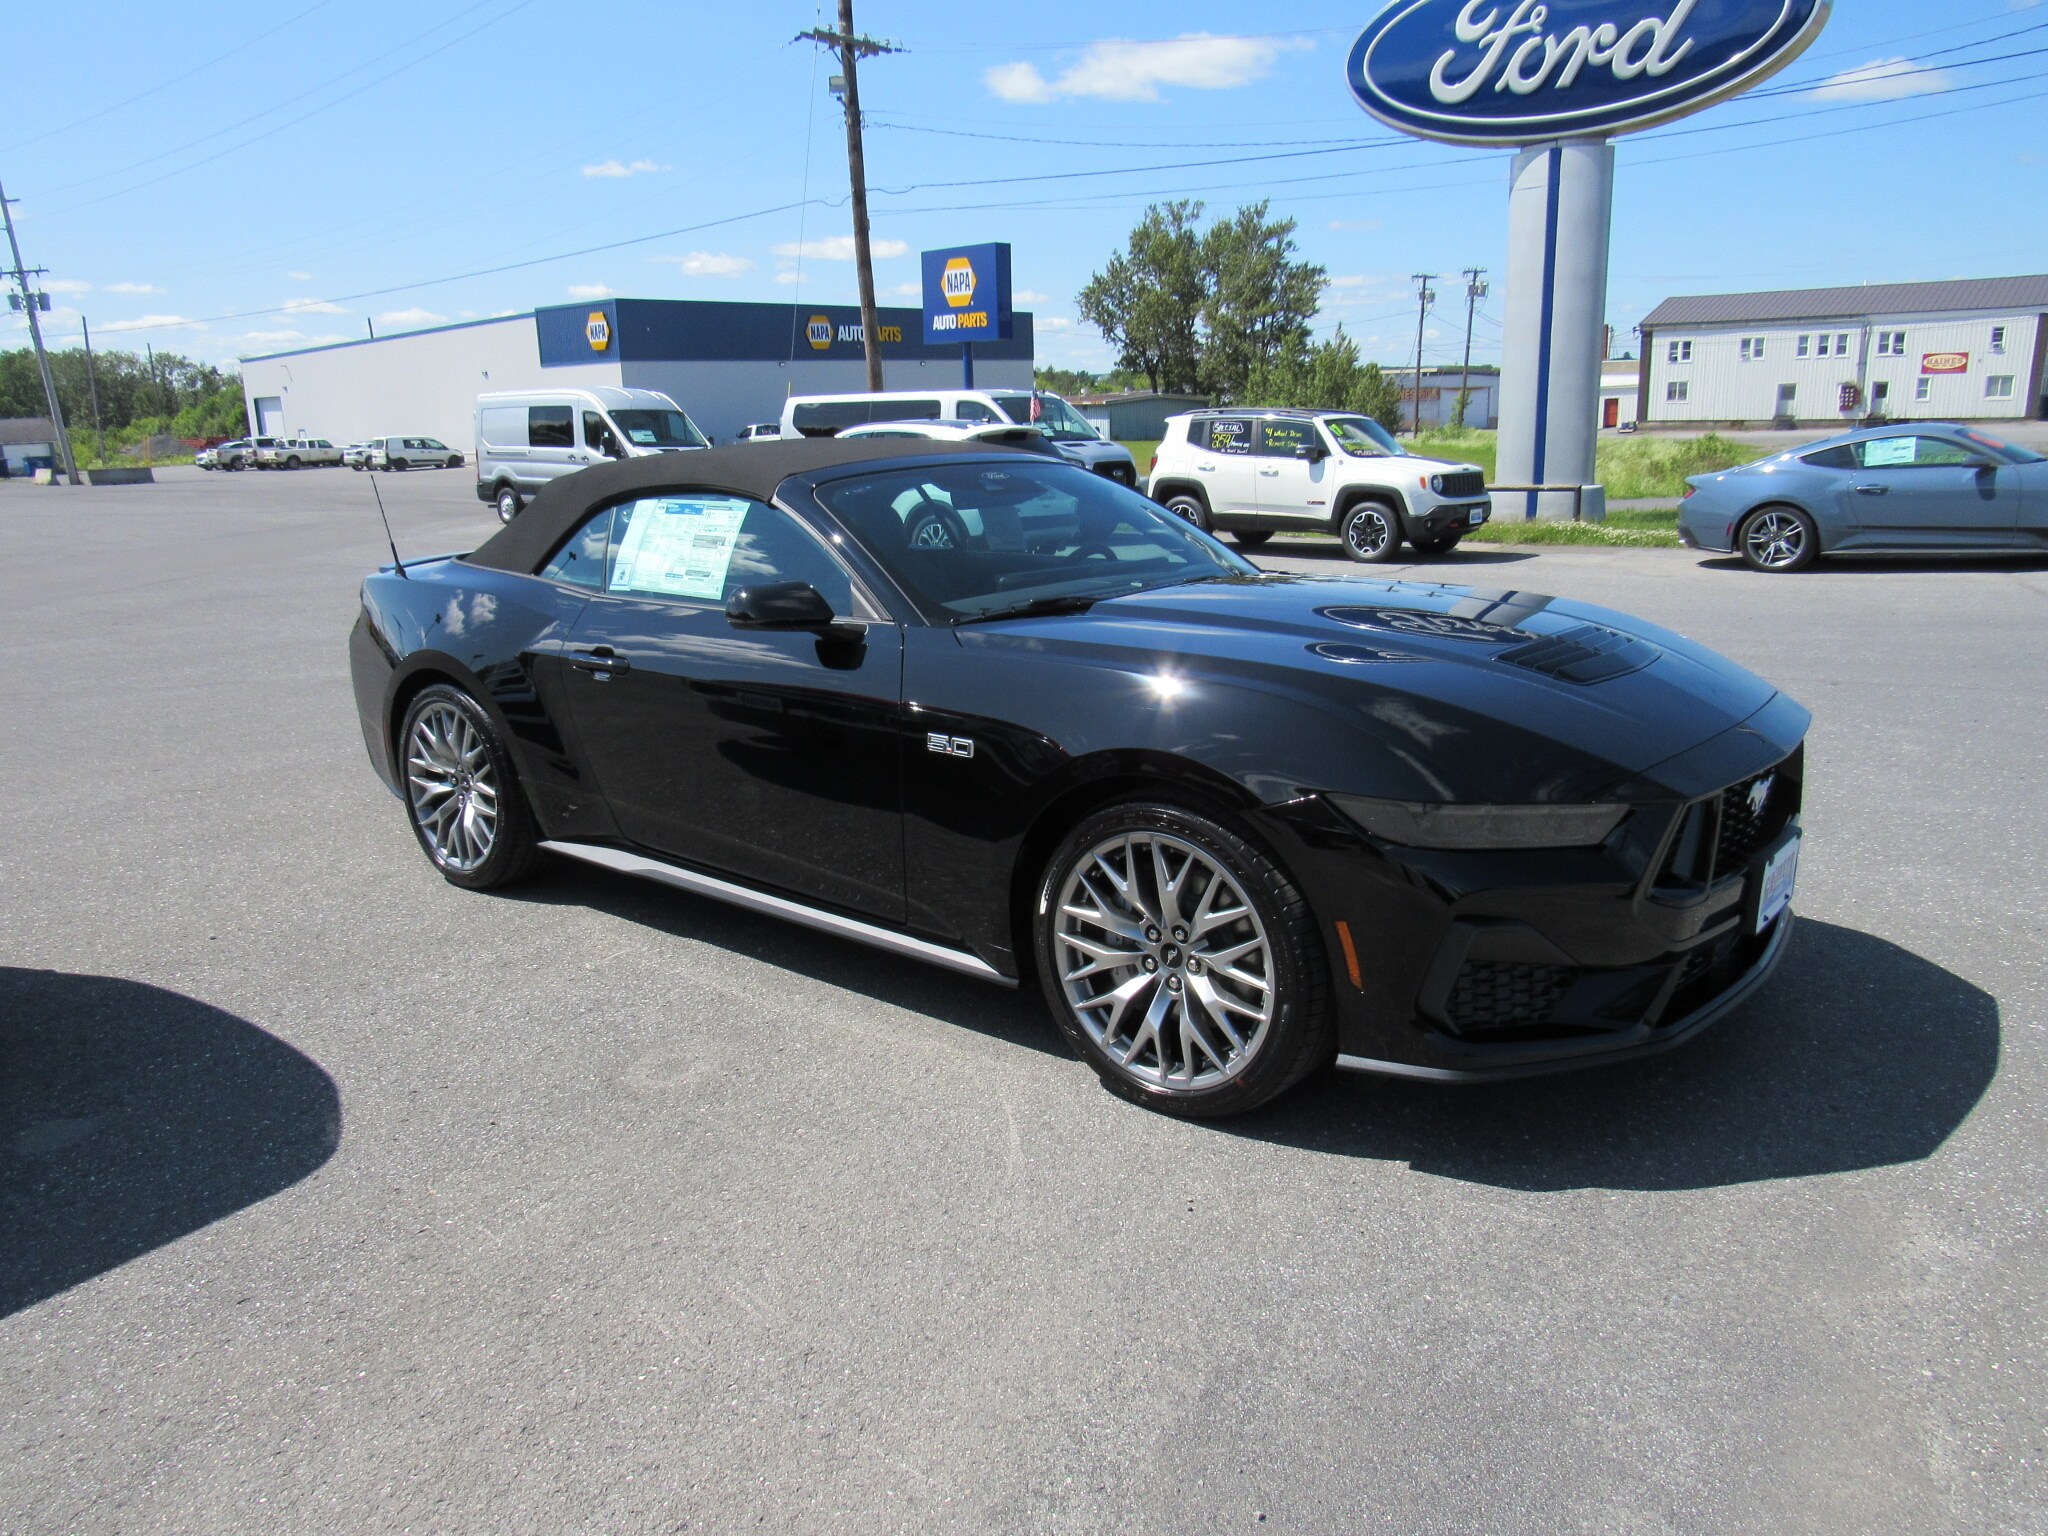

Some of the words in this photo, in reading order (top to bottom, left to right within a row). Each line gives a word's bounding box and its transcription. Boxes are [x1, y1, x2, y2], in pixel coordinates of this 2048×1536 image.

[1429, 0, 1695, 104] Ford
[947, 271, 971, 293] NAPA
[933, 315, 956, 330] AUTO
[958, 312, 987, 328] PARTS
[589, 323, 607, 341] NAPA
[810, 324, 830, 340] NAPA
[838, 325, 864, 342] AUTO
[878, 326, 902, 342] ARTS
[927, 732, 974, 758] 5.0
